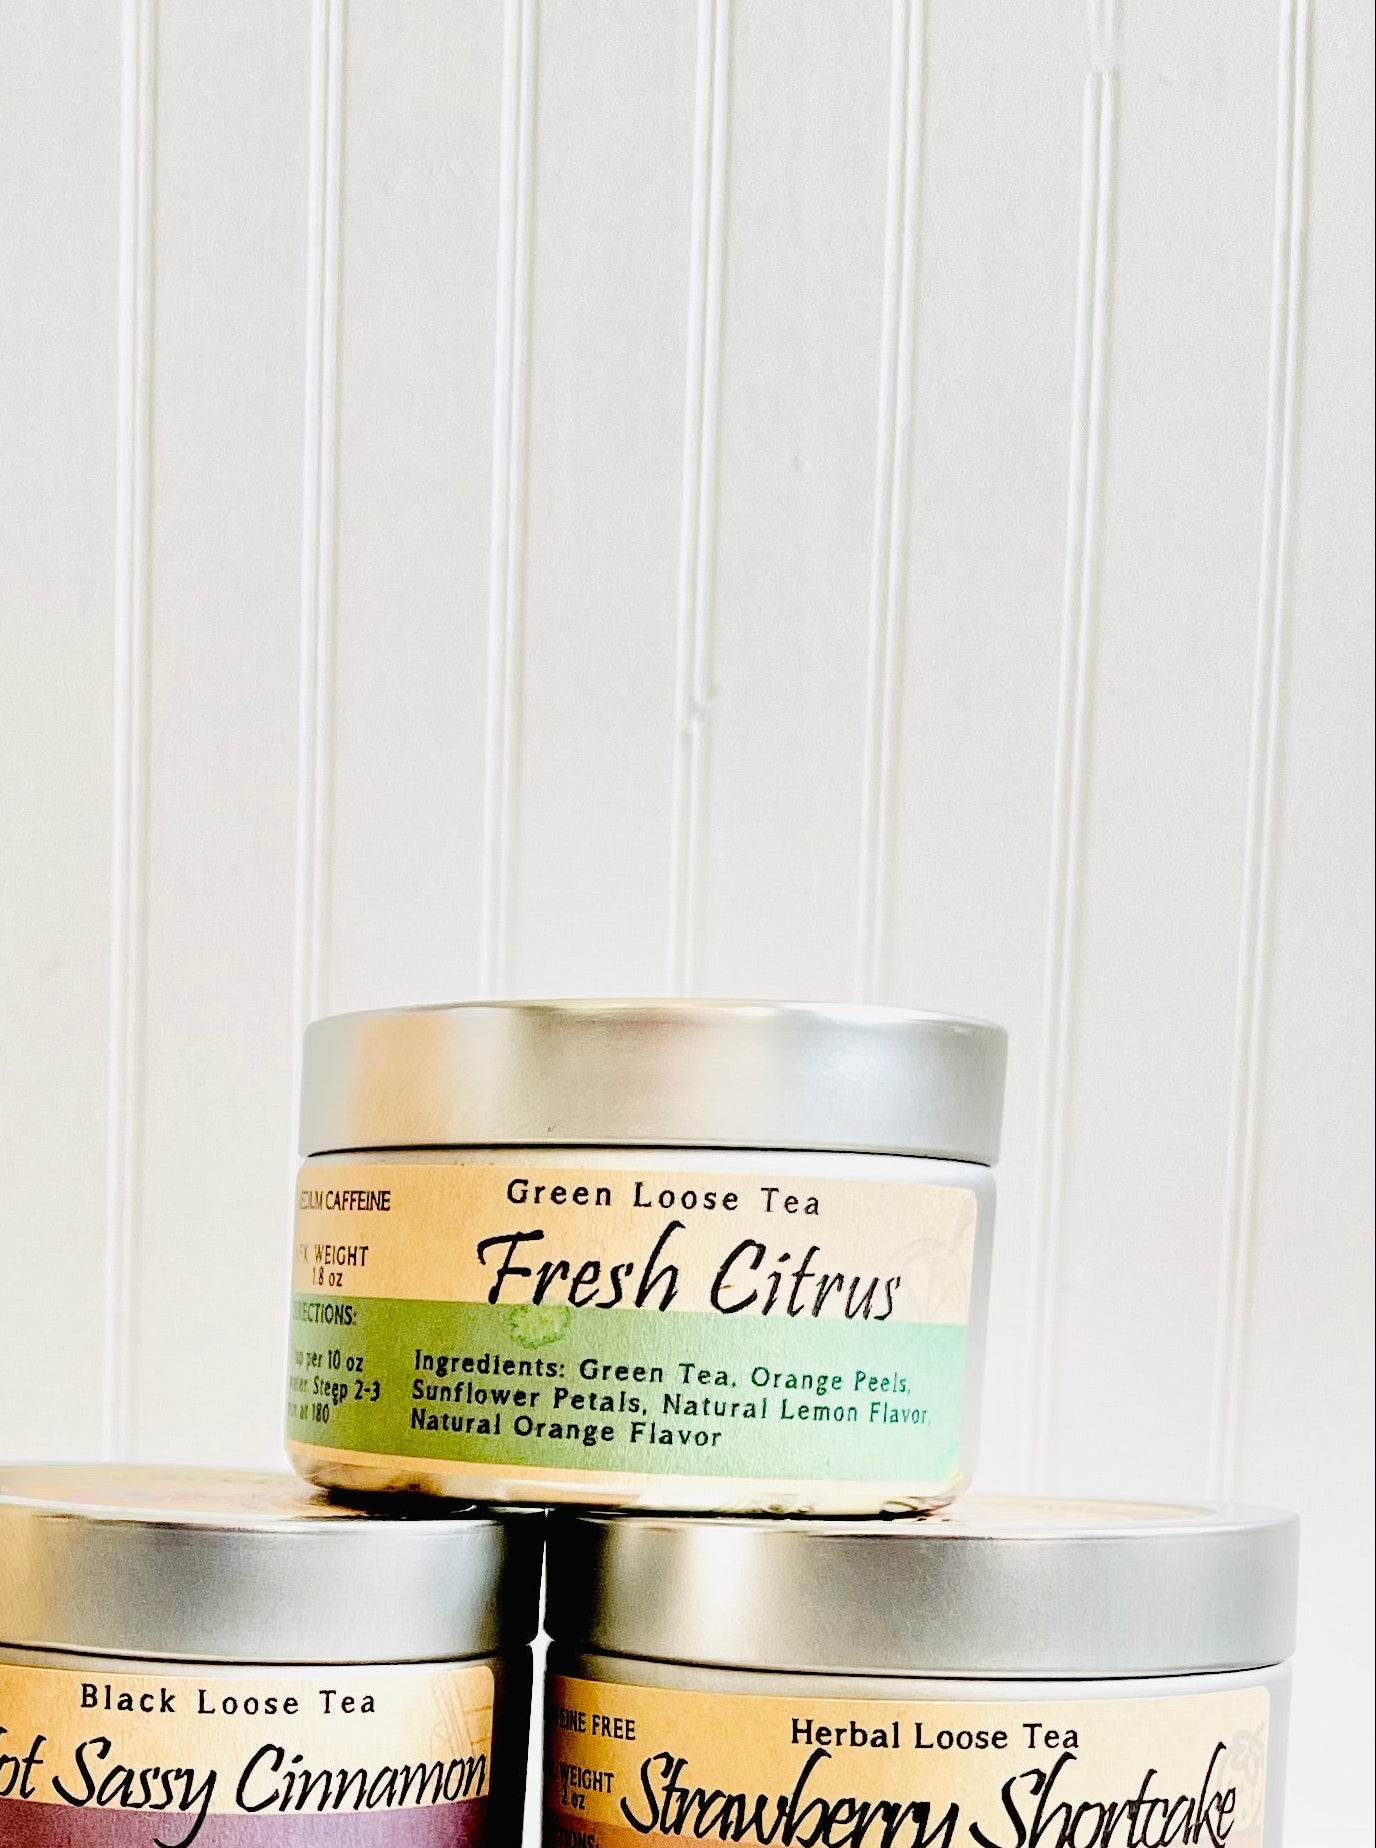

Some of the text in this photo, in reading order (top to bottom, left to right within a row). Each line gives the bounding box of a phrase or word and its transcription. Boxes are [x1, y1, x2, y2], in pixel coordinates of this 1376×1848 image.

[326, 1190, 391, 1212] CAFFEINE
[507, 1178, 820, 1216] Green Loose Tea
[314, 1244, 369, 1267] WEIGHT
[476, 1220, 901, 1322] Fresh Citrus
[327, 1350, 341, 1370] 10
[346, 1356, 364, 1372] oz
[415, 1349, 565, 1378] Ingredients:
[579, 1358, 664, 1383] Green
[751, 1366, 843, 1396] Orange
[854, 1370, 912, 1395] Peels,
[313, 1376, 348, 1403] Steep
[354, 1379, 381, 1402] 2-3
[412, 1378, 540, 1408] Sunflower
[553, 1386, 647, 1415] Petals,
[662, 1393, 768, 1419] Natural
[780, 1398, 858, 1423] Lemon
[411, 1407, 723, 1447] Natural Orange Flavor
[81, 1683, 376, 1716] Black Loose Tea
[592, 1714, 636, 1741] FREE
[791, 1718, 1080, 1749] Herbal Loose Tea
[237, 1743, 487, 1814] Cinnamon
[560, 1762, 614, 1794] WEIGHT
[571, 1791, 586, 1811] oz
